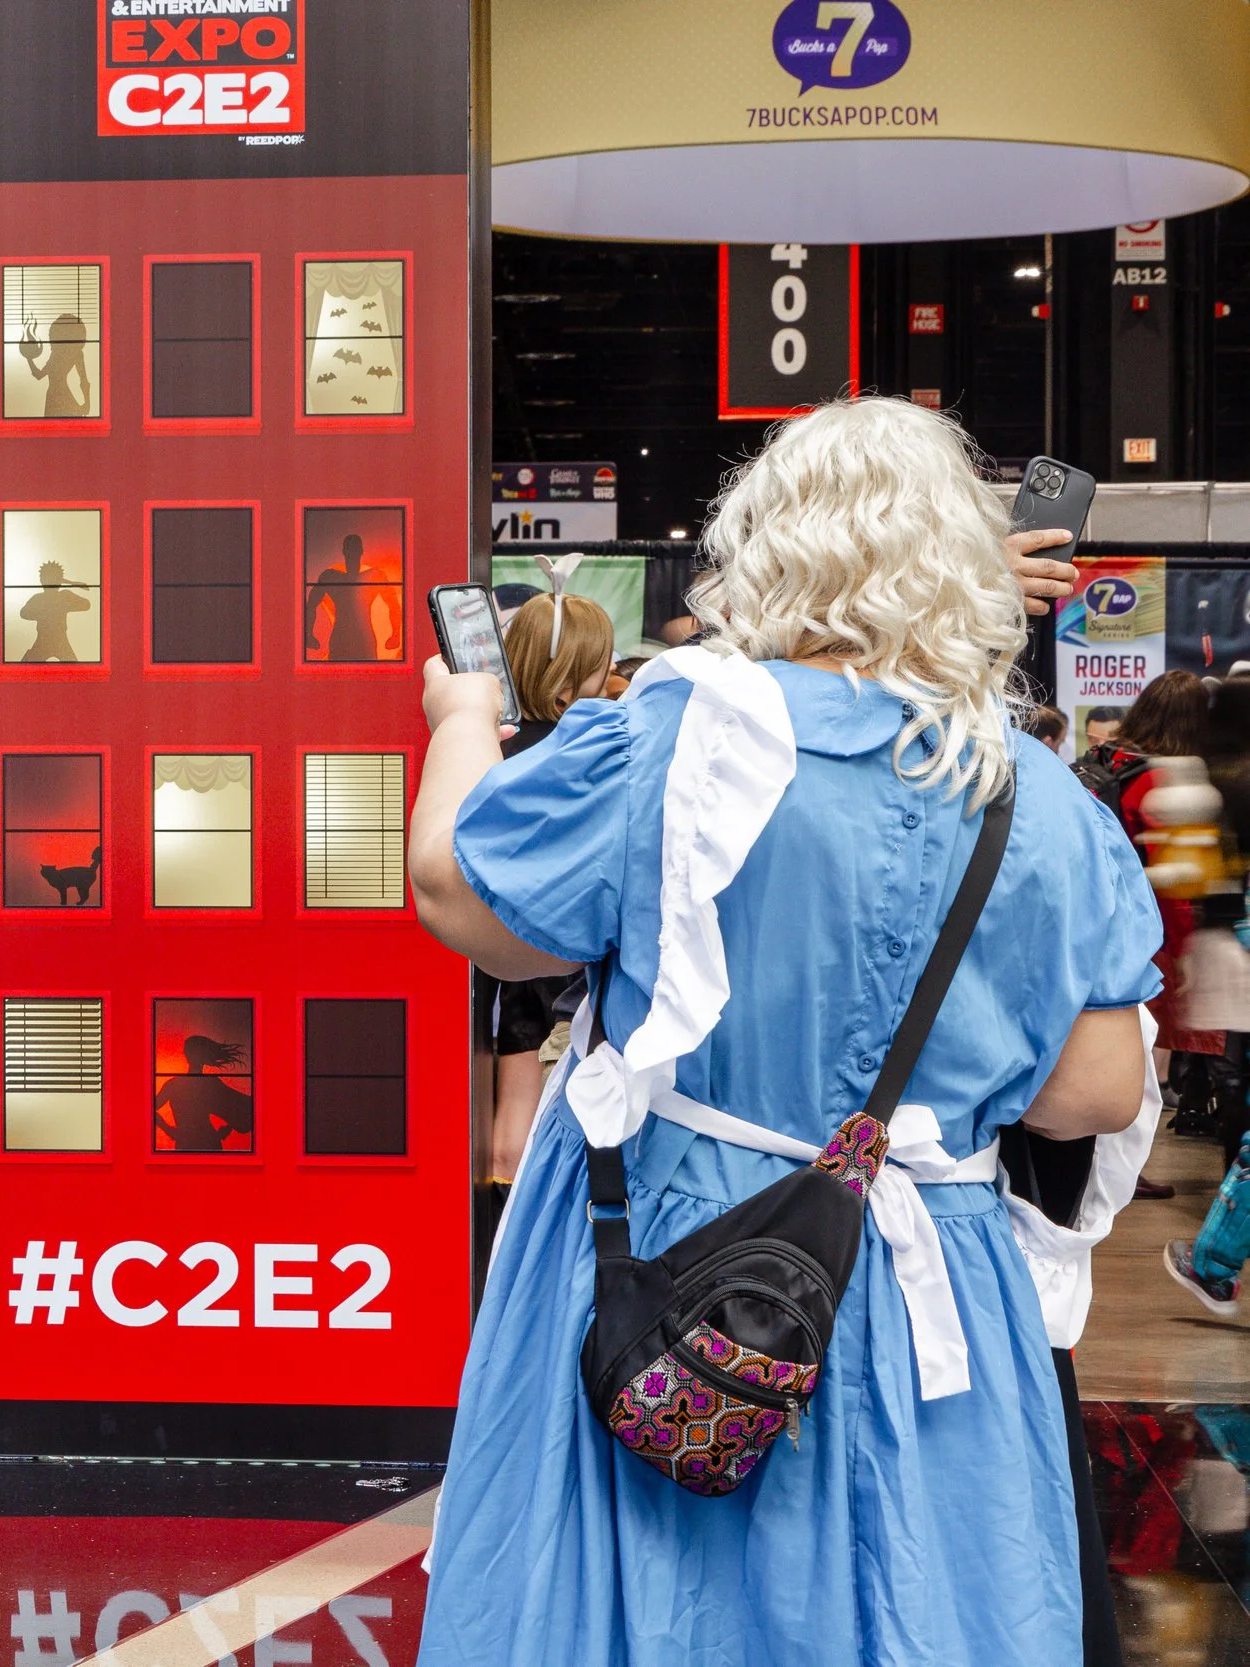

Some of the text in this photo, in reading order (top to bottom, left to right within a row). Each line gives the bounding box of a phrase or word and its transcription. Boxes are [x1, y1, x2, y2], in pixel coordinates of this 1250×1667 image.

[131, 0, 291, 15] ENTERTAINMENT
[111, 16, 292, 62] EXPO
[788, 39, 825, 54] Bucks
[816, 2, 875, 77] 7
[108, 71, 291, 127] C2E2
[746, 106, 938, 127] 7BUCKSAPOP.COM
[1112, 267, 1167, 285] AB12
[1093, 583, 1116, 612] 7
[1089, 620, 1131, 633] Signature
[1075, 655, 1146, 679] ROGER
[1080, 681, 1142, 697] JACKSON
[8, 1240, 392, 1329] #C2E2
